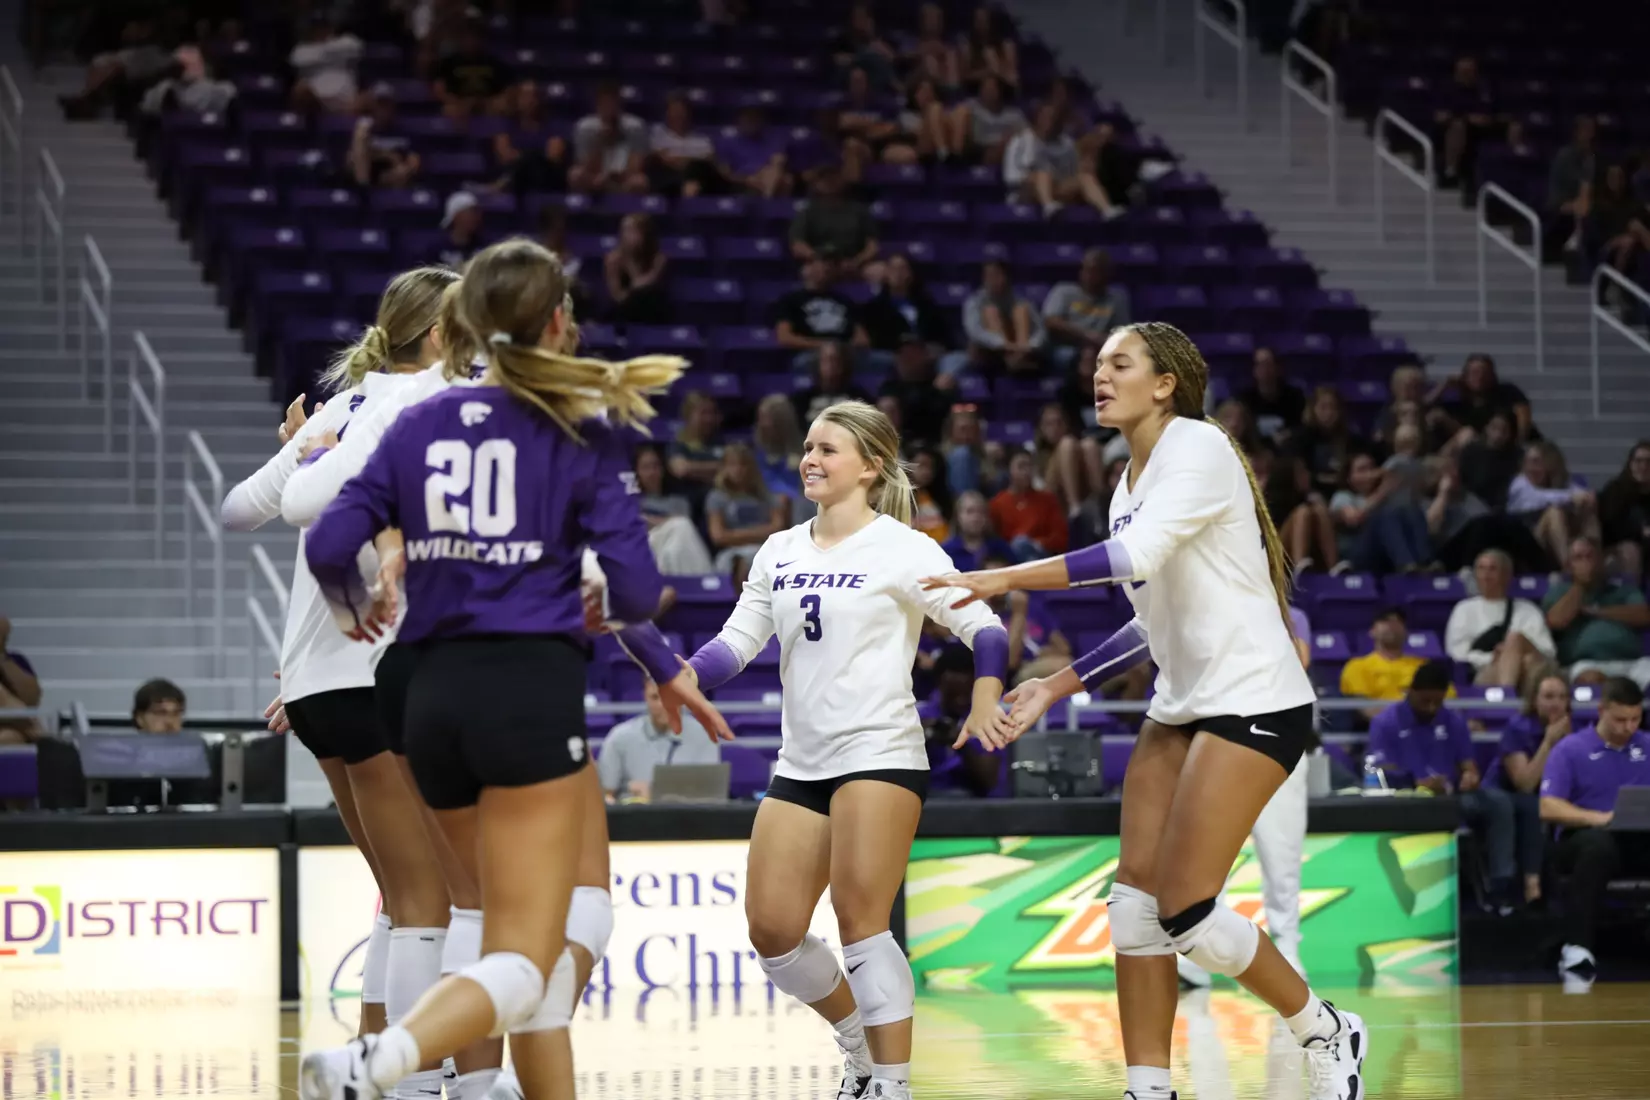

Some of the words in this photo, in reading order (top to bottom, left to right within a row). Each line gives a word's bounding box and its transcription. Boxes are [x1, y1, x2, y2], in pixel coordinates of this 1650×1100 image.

[425, 438, 517, 537] 20
[406, 537, 544, 566] WILDCATS
[772, 573, 867, 591] K-STATE
[800, 594, 822, 641] 3
[4, 897, 268, 942] DISTRICT
